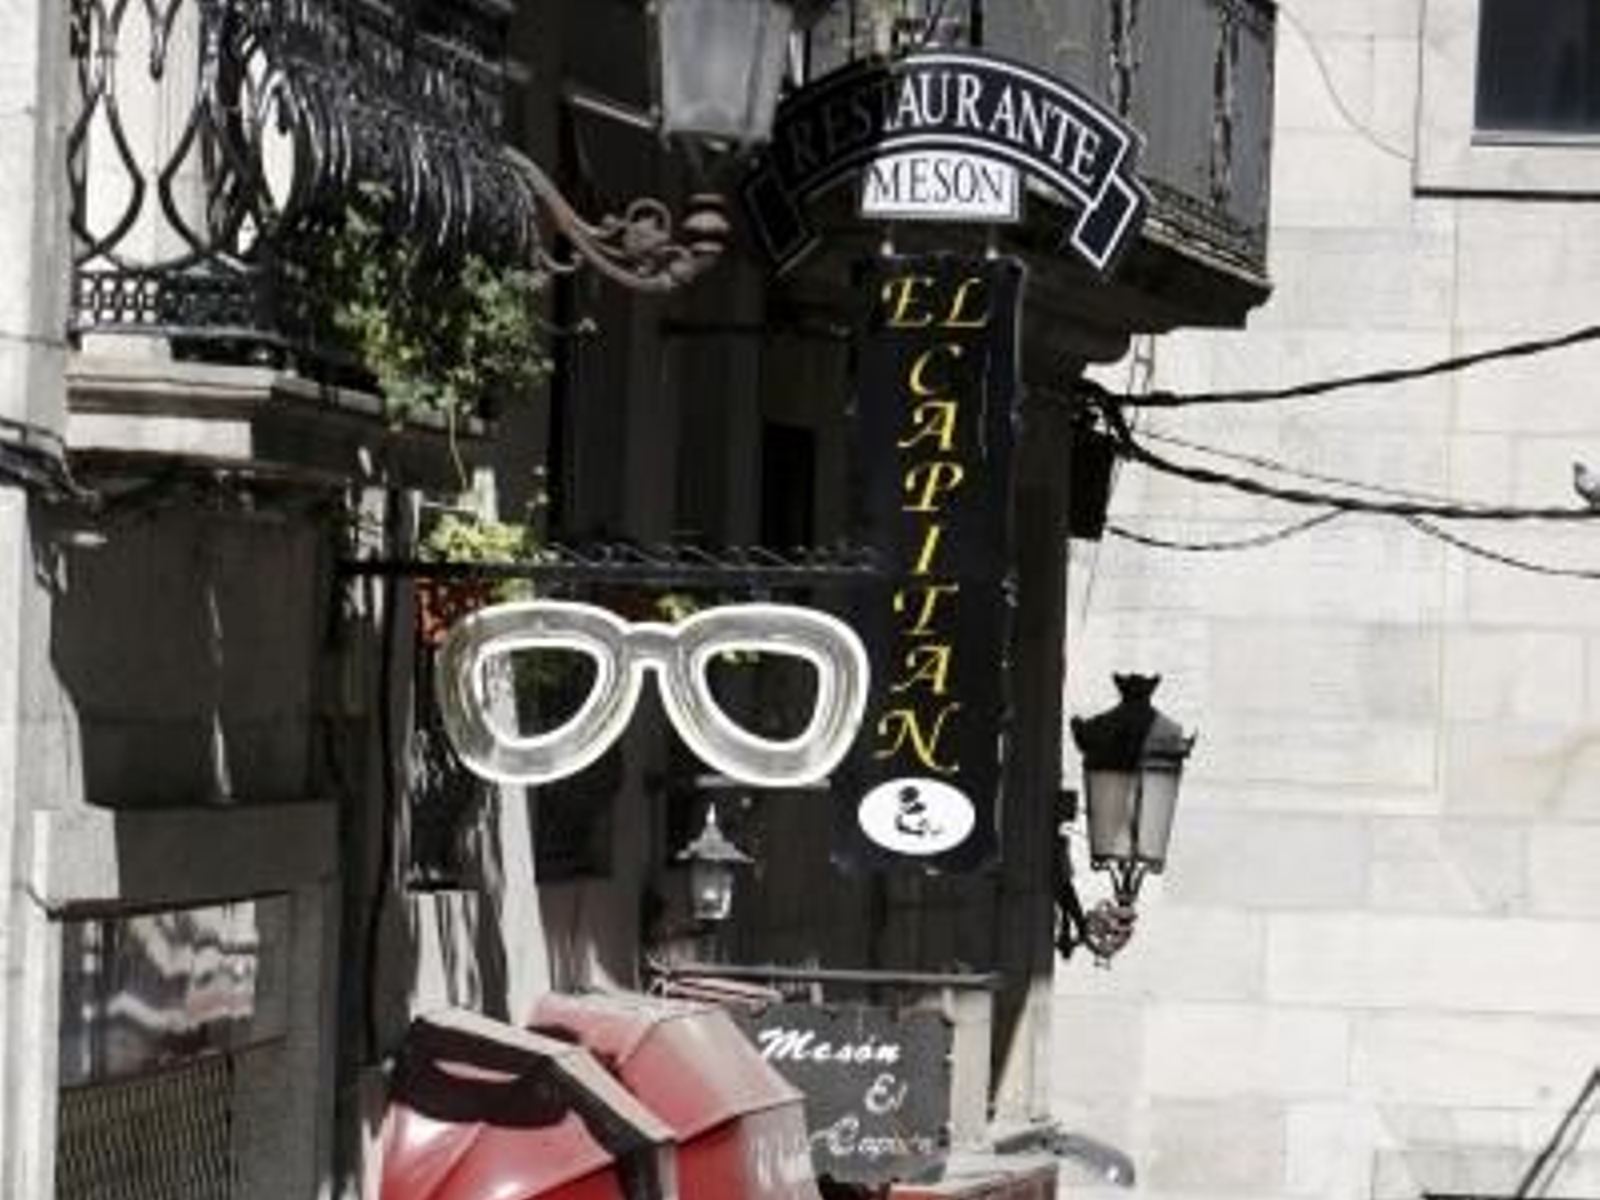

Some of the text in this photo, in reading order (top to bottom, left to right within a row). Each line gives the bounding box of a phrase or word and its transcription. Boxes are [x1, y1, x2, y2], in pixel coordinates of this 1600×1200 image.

[786, 72, 1100, 185] RESTAURANTE
[867, 158, 1003, 203] MESON
[882, 277, 988, 328] EL
[873, 345, 965, 773] CAPITAN
